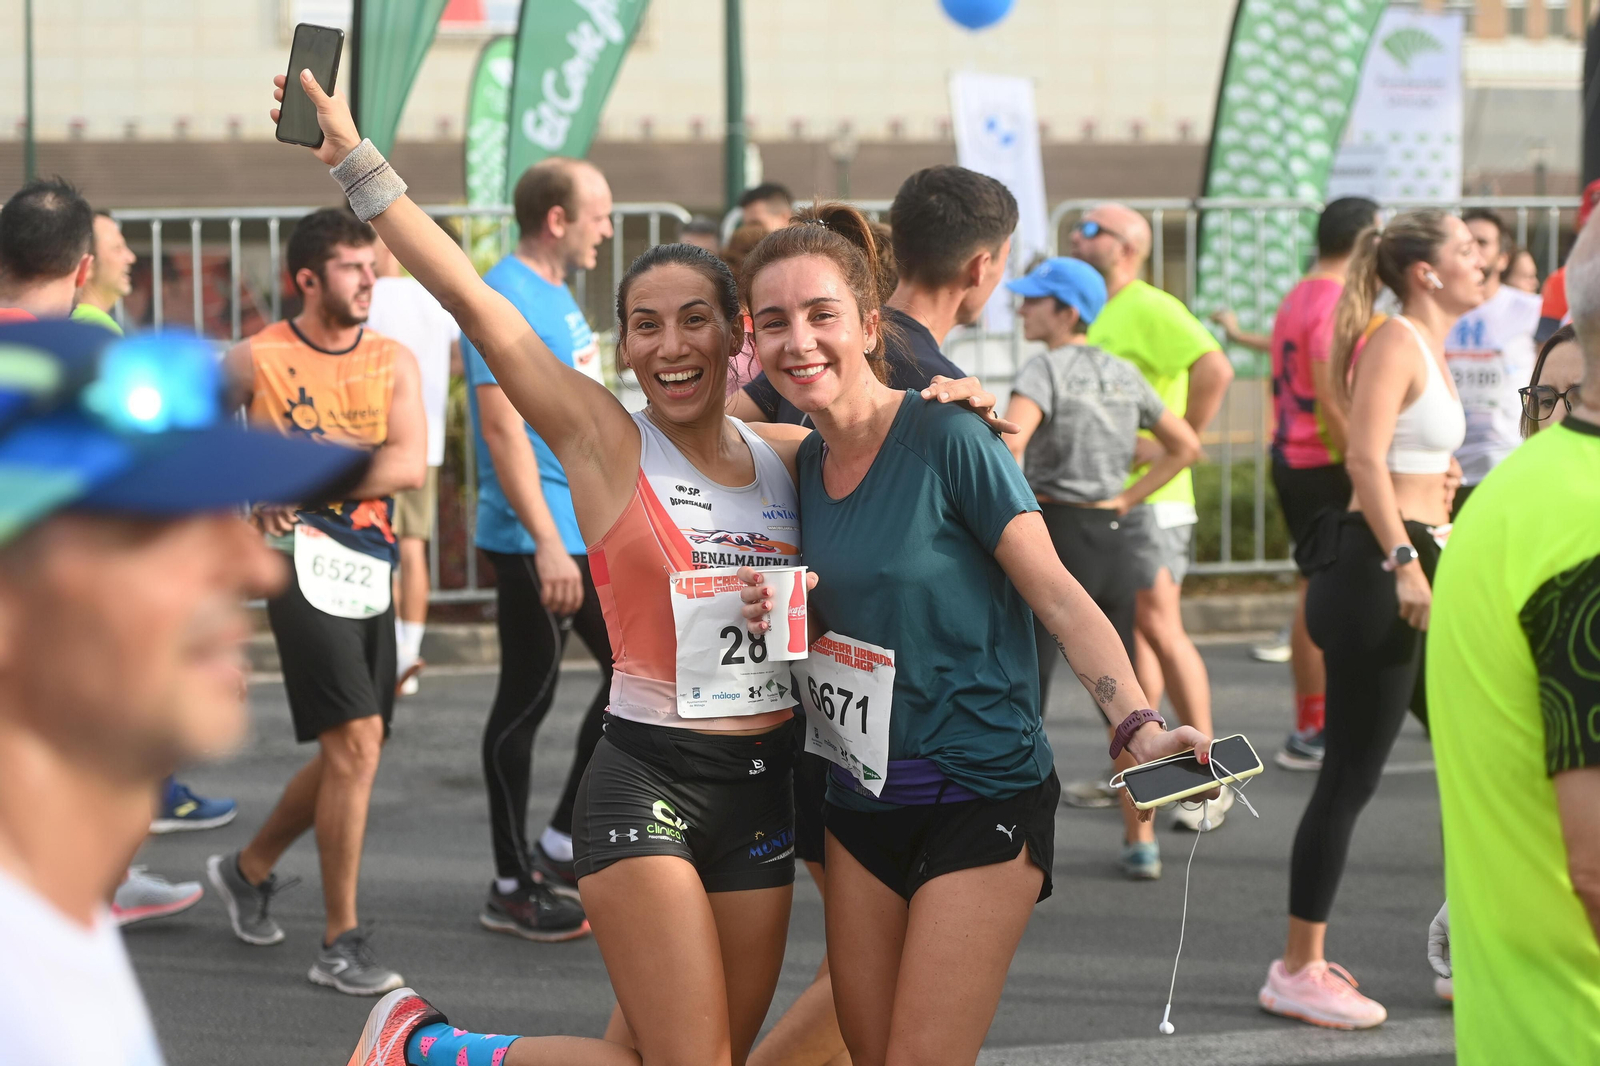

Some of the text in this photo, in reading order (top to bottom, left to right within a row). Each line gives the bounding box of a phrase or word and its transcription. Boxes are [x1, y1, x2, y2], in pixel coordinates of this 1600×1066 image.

[692, 551, 789, 567] BENALMADENA
[312, 554, 374, 588] 6522
[674, 577, 715, 599] 42
[854, 646, 894, 668] URBANA
[712, 691, 741, 701] málaga
[807, 675, 869, 735] 6671
